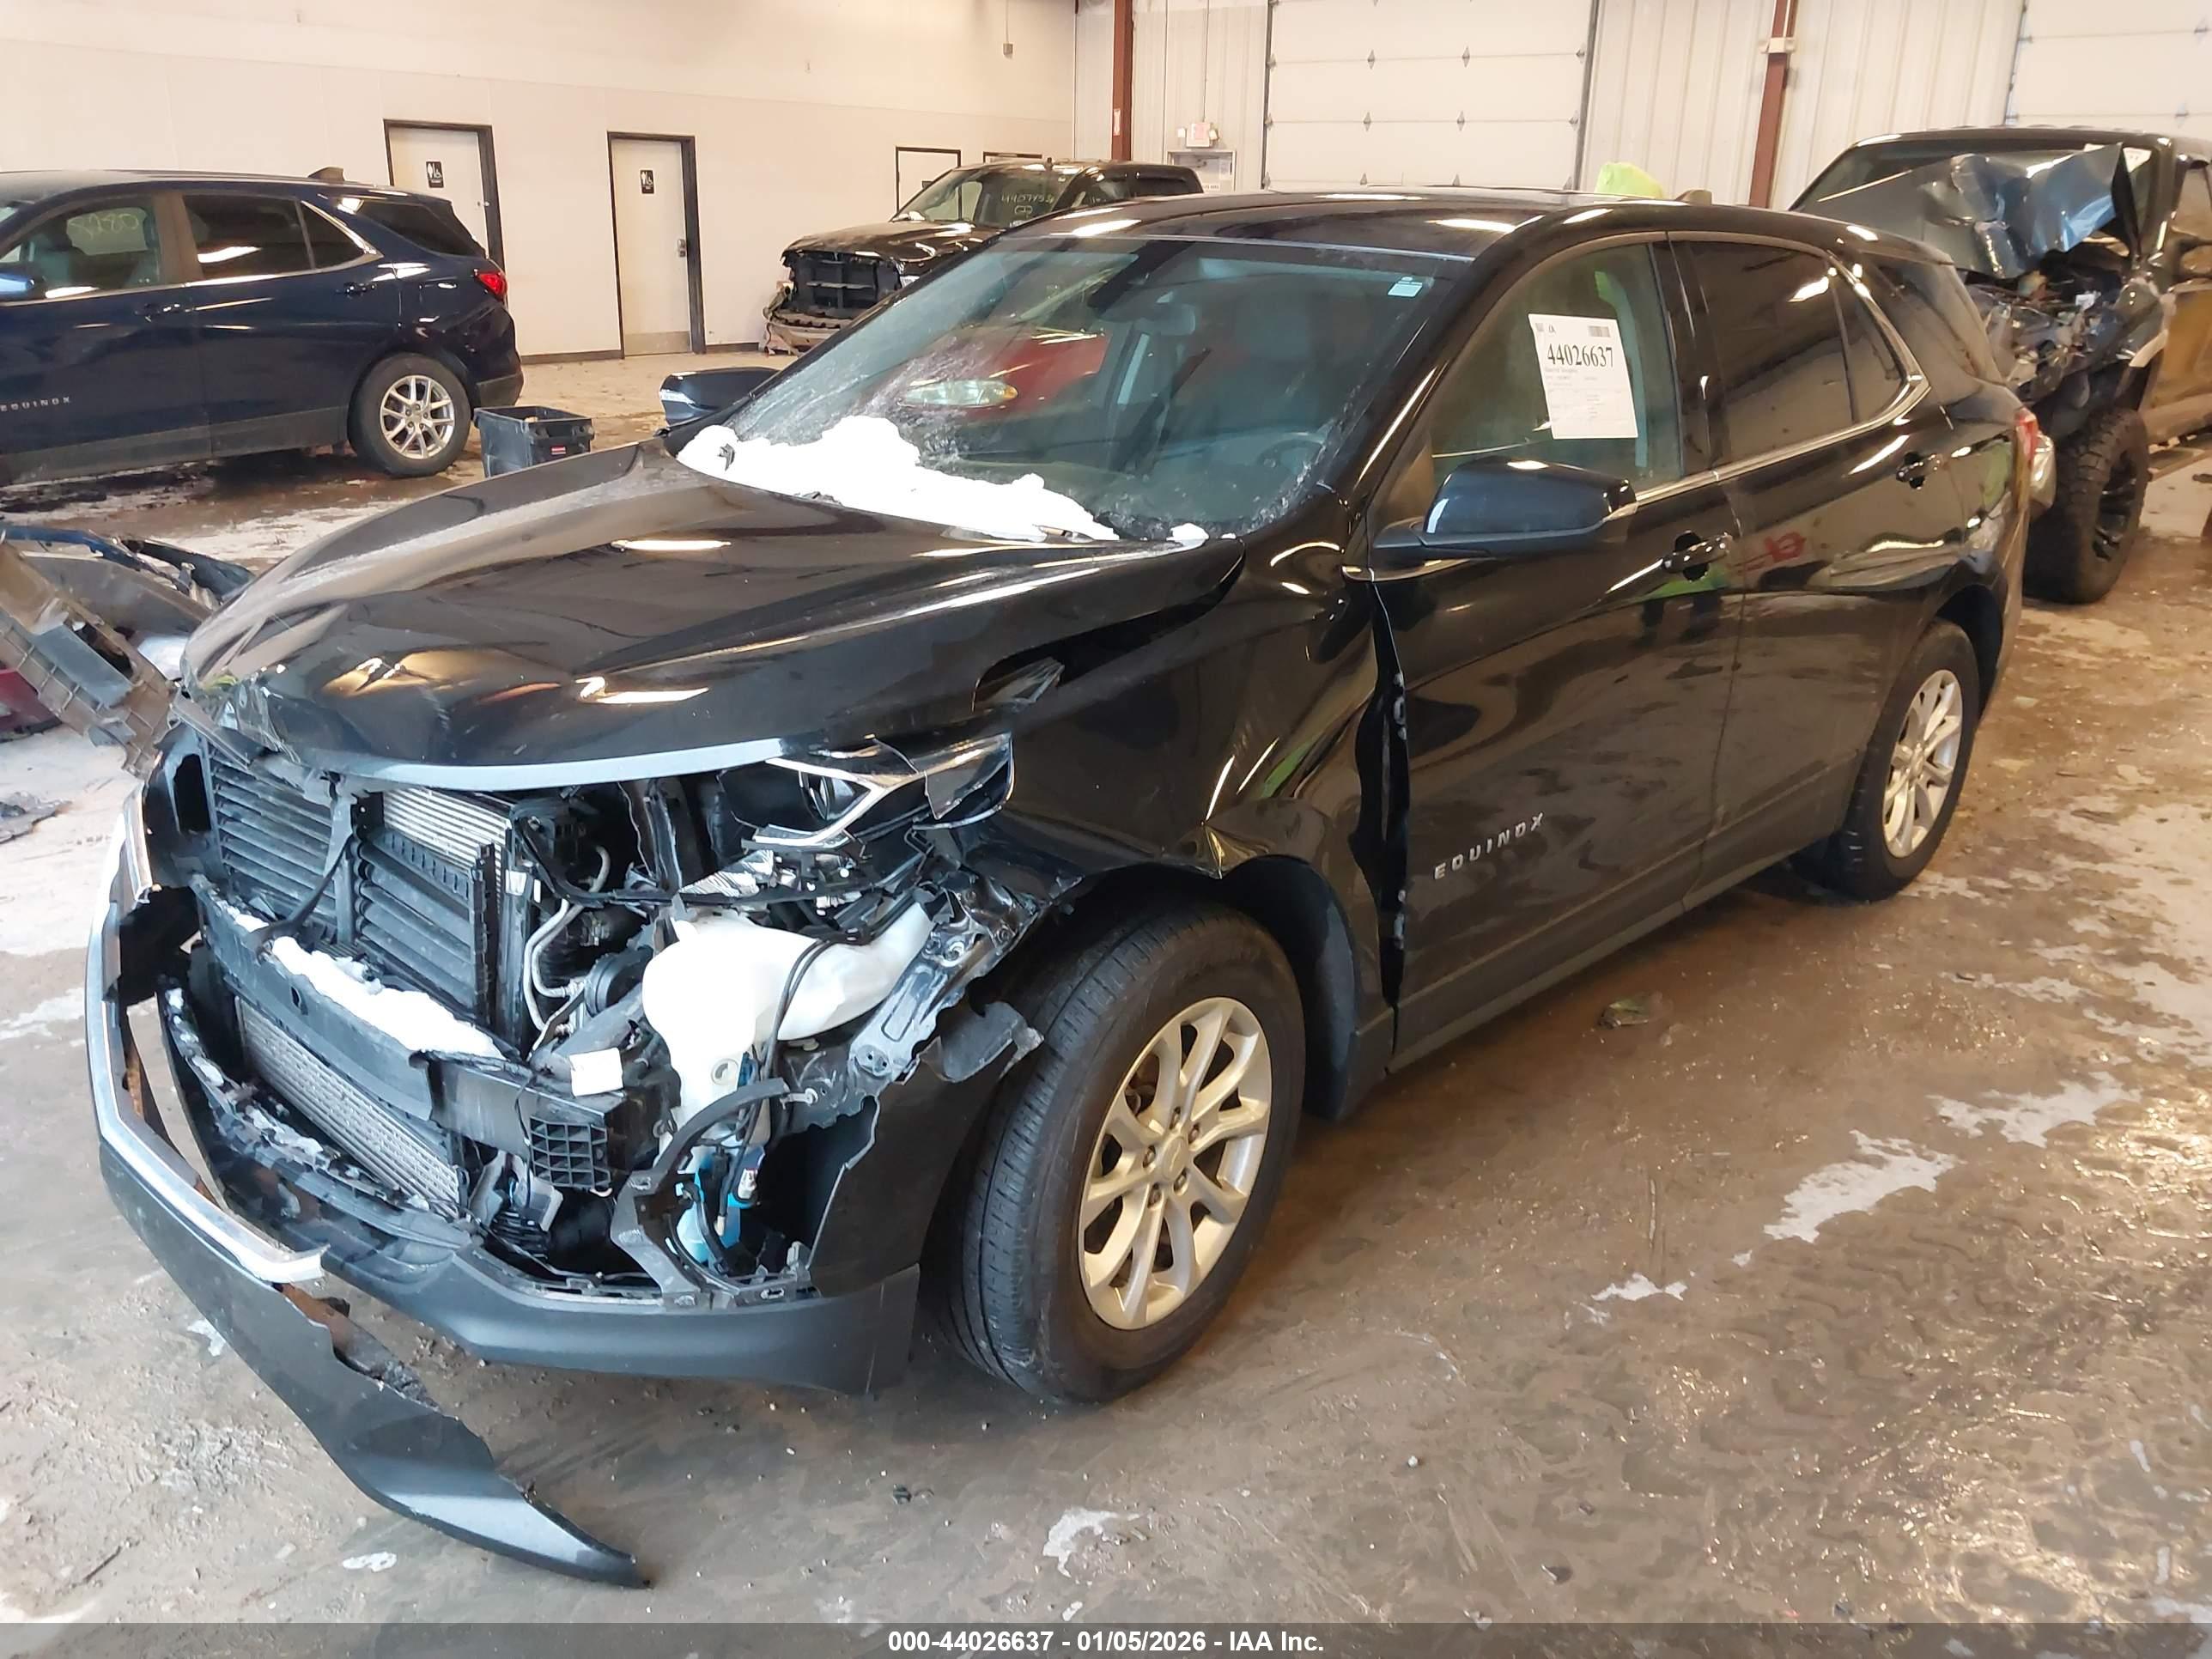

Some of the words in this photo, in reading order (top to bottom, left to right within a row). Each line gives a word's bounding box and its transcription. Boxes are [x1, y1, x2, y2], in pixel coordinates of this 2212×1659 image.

[1547, 343, 1614, 368] 44026637
[0, 396, 70, 412] EQUINOX
[1433, 811, 1545, 880] EQUINOX
